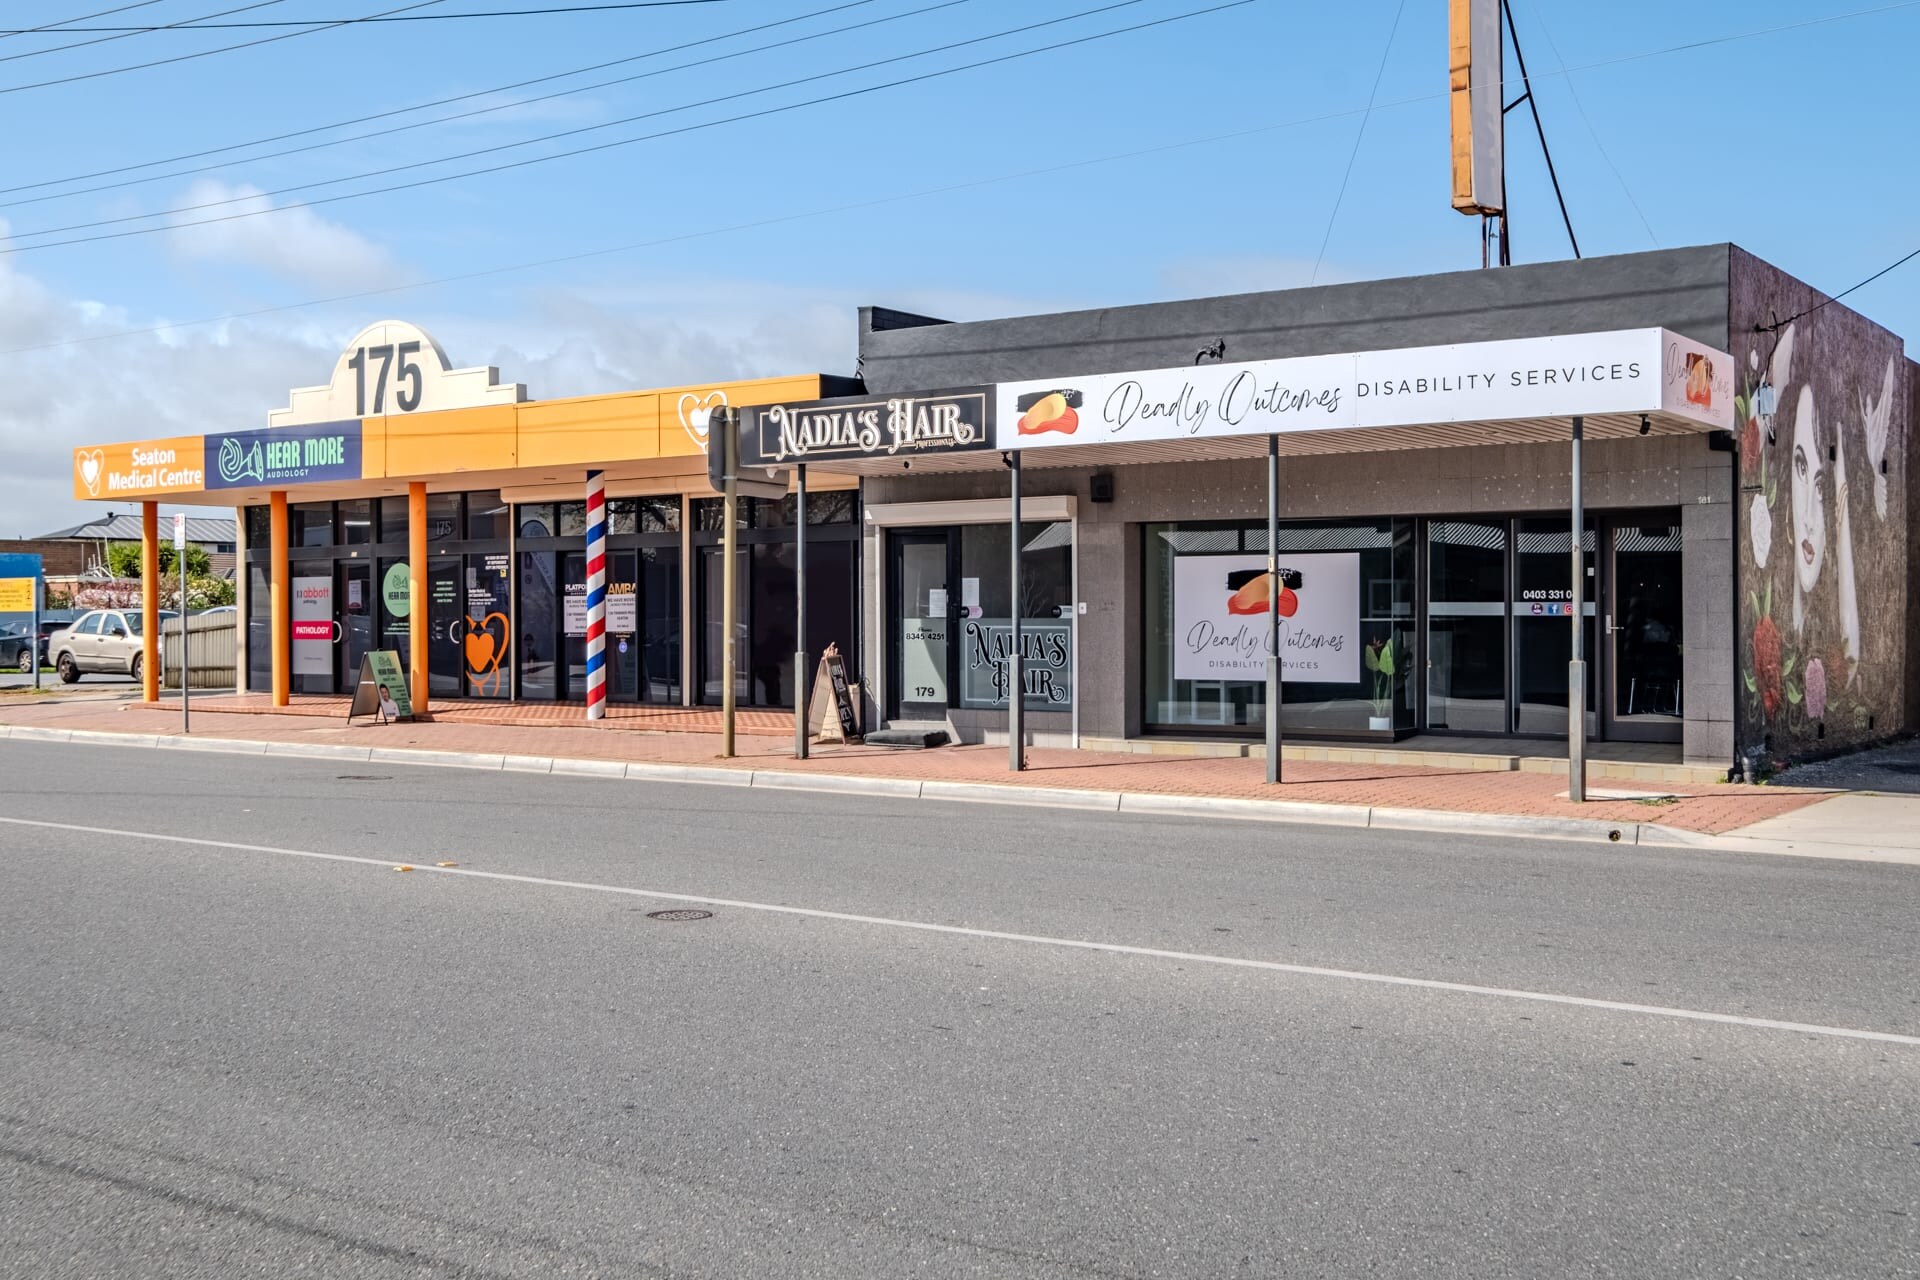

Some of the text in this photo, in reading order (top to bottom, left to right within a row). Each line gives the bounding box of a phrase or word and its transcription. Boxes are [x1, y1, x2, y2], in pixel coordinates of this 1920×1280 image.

[348, 340, 422, 416] 175
[1103, 362, 1642, 434] Deadly Outcomes DISABILITY SERVICES
[769, 398, 975, 461] NADIA'S HAIR
[131, 448, 176, 467] Seaton
[266, 436, 345, 469] HEAR MORE
[108, 468, 202, 491] Medical Centre
[266, 468, 309, 479] AUDIOLOGY
[436, 520, 452, 535] 175
[303, 587, 329, 599] abbott
[1523, 590, 1547, 599] 0403
[1548, 590, 1564, 599] 331
[296, 626, 329, 634] PATHOLOGY
[1187, 620, 1259, 658] Deadly
[1209, 660, 1319, 669] DISABILITY RVICES
[915, 687, 935, 696] 179
